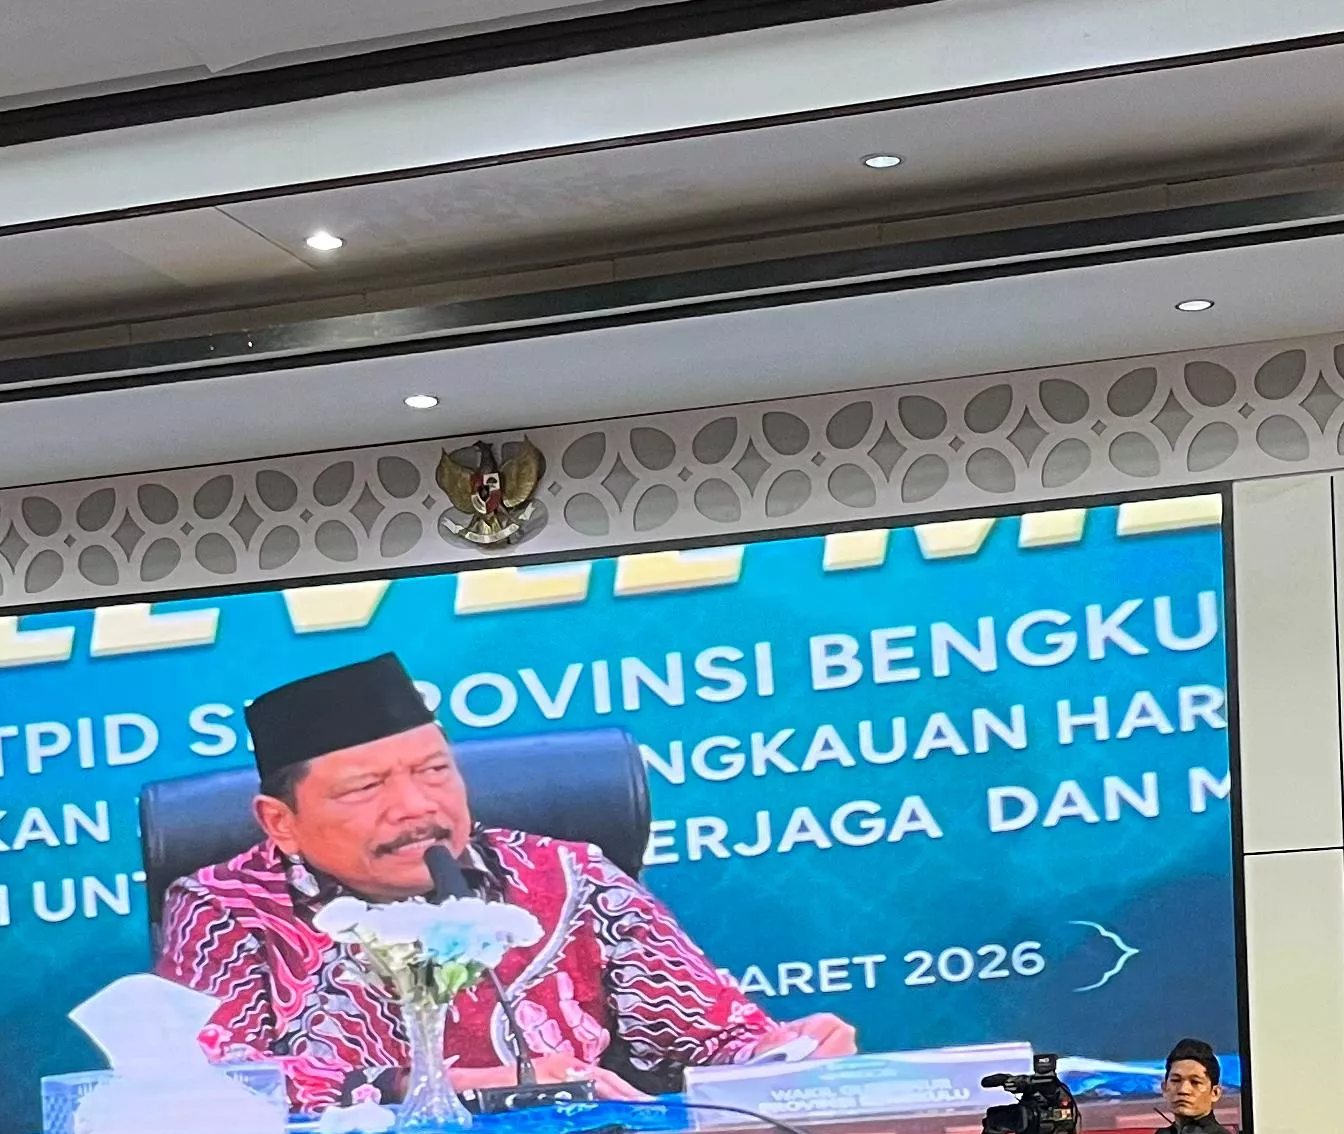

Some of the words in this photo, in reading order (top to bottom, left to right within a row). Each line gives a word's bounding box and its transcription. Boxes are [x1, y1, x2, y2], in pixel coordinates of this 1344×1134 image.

[808, 590, 1220, 691] BENGKU
[1056, 683, 1228, 745] HAR
[32, 870, 147, 922] UN
[987, 771, 1160, 833] DAN
[720, 953, 886, 997] ARET
[903, 940, 1046, 987] 2026
